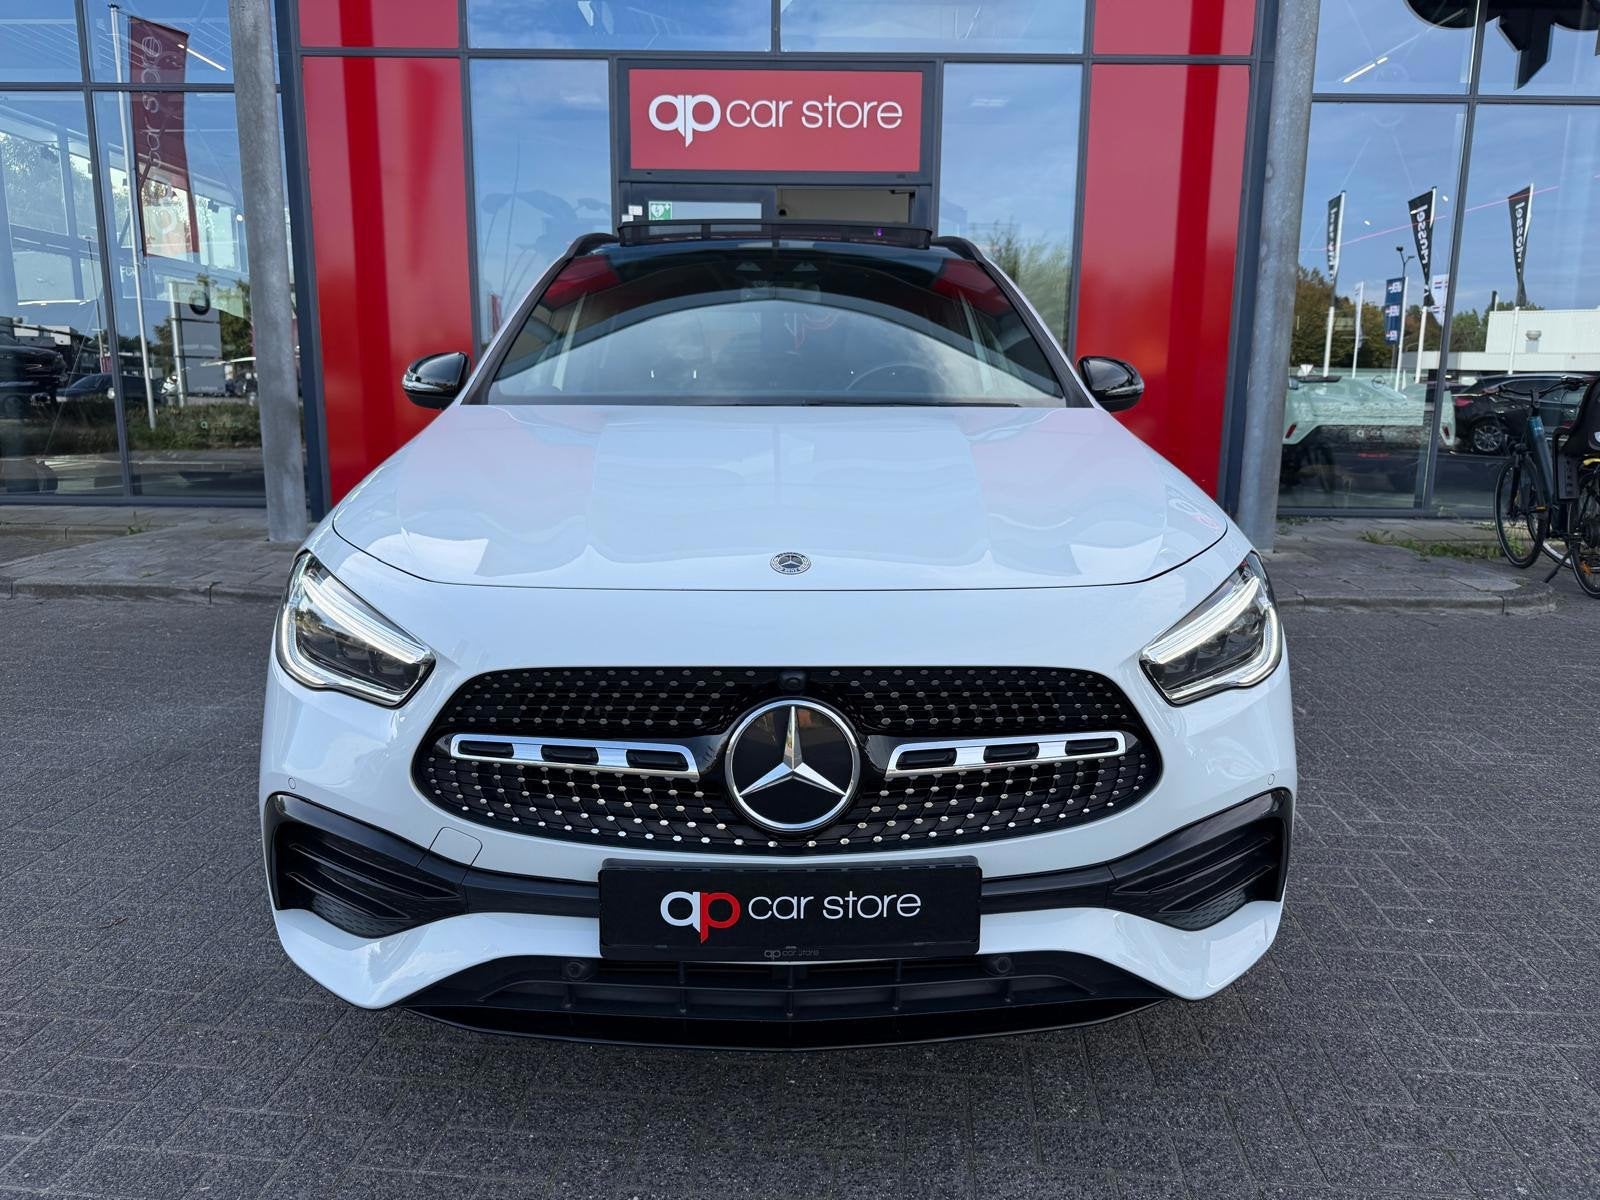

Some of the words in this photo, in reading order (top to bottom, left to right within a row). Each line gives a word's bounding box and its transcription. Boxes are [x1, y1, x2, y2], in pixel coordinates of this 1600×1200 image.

[141, 36, 163, 114] sore
[726, 99, 793, 128] car
[801, 95, 903, 128] store
[748, 894, 815, 921] car
[823, 890, 922, 920] store
